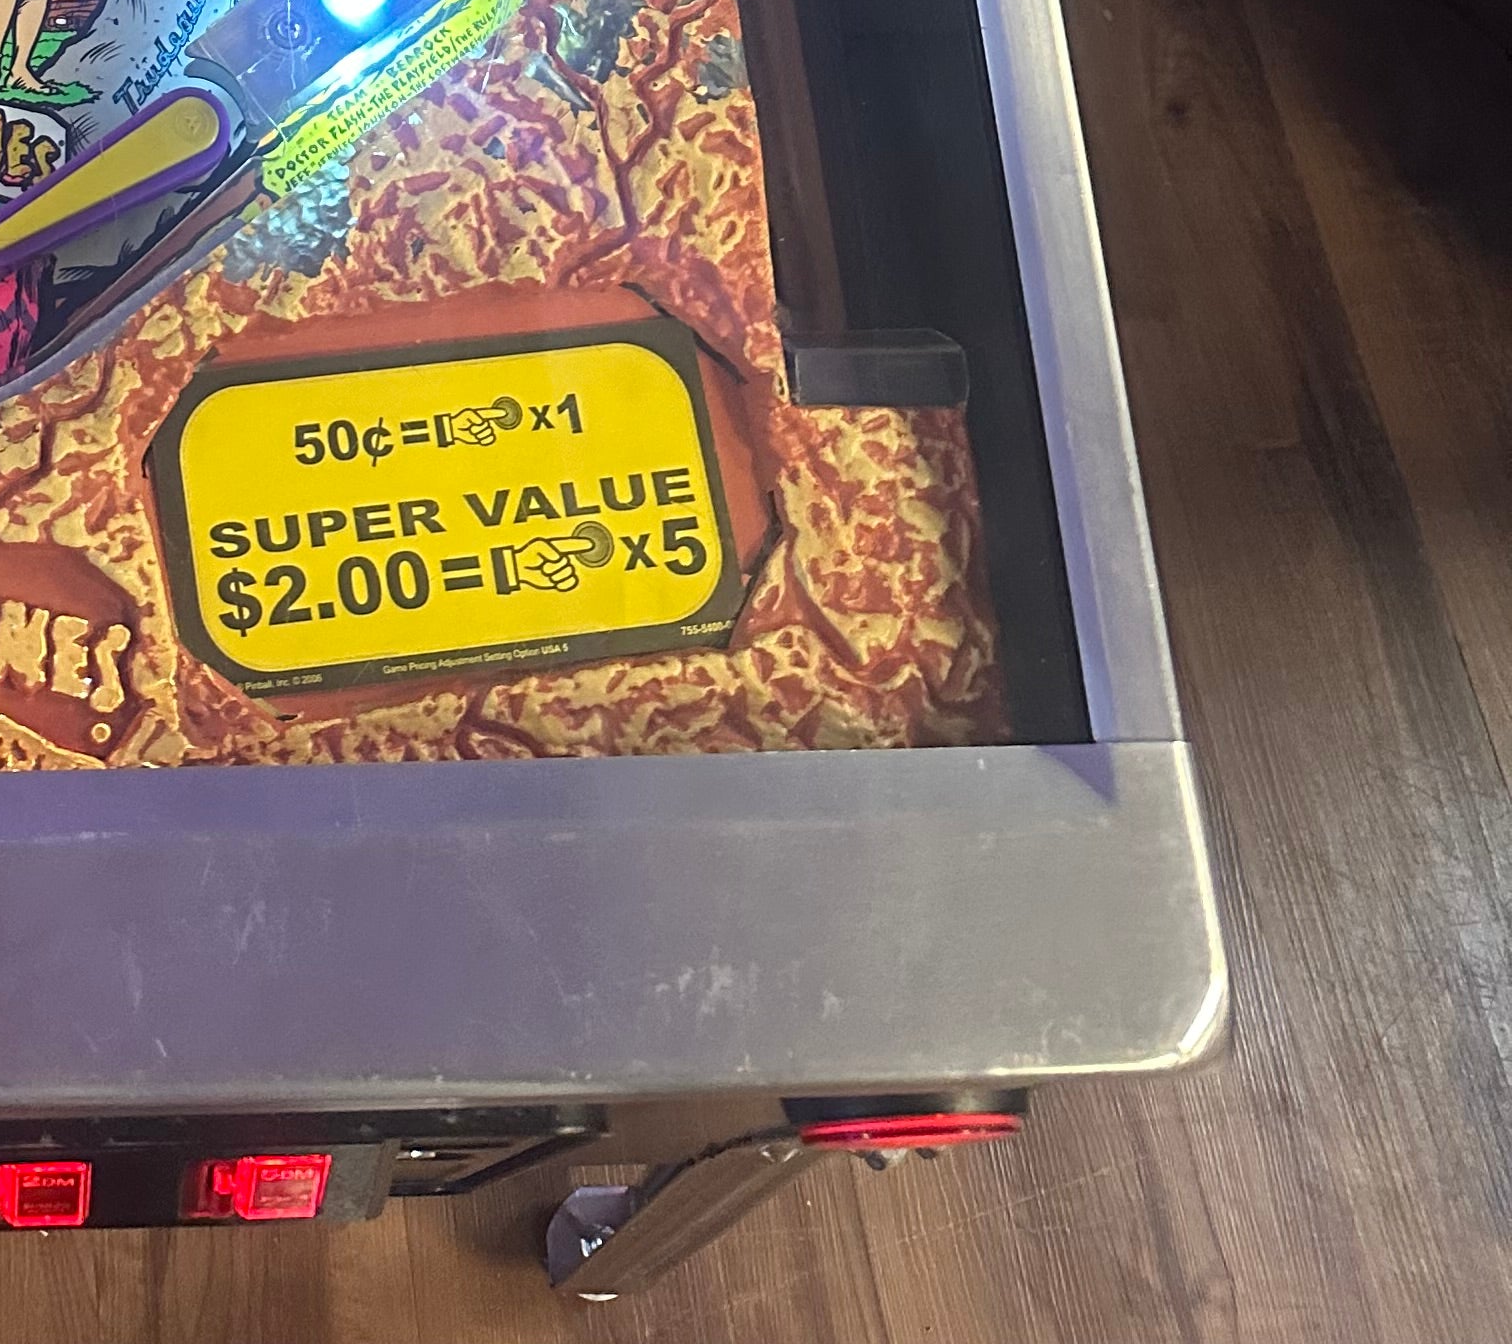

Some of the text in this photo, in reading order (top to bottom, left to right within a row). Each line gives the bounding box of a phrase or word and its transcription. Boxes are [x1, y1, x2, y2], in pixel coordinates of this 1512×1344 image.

[530, 393, 585, 436] x1
[209, 467, 698, 560] SUPER VALUE
[618, 515, 709, 578] x5
[541, 644, 563, 656] USA
